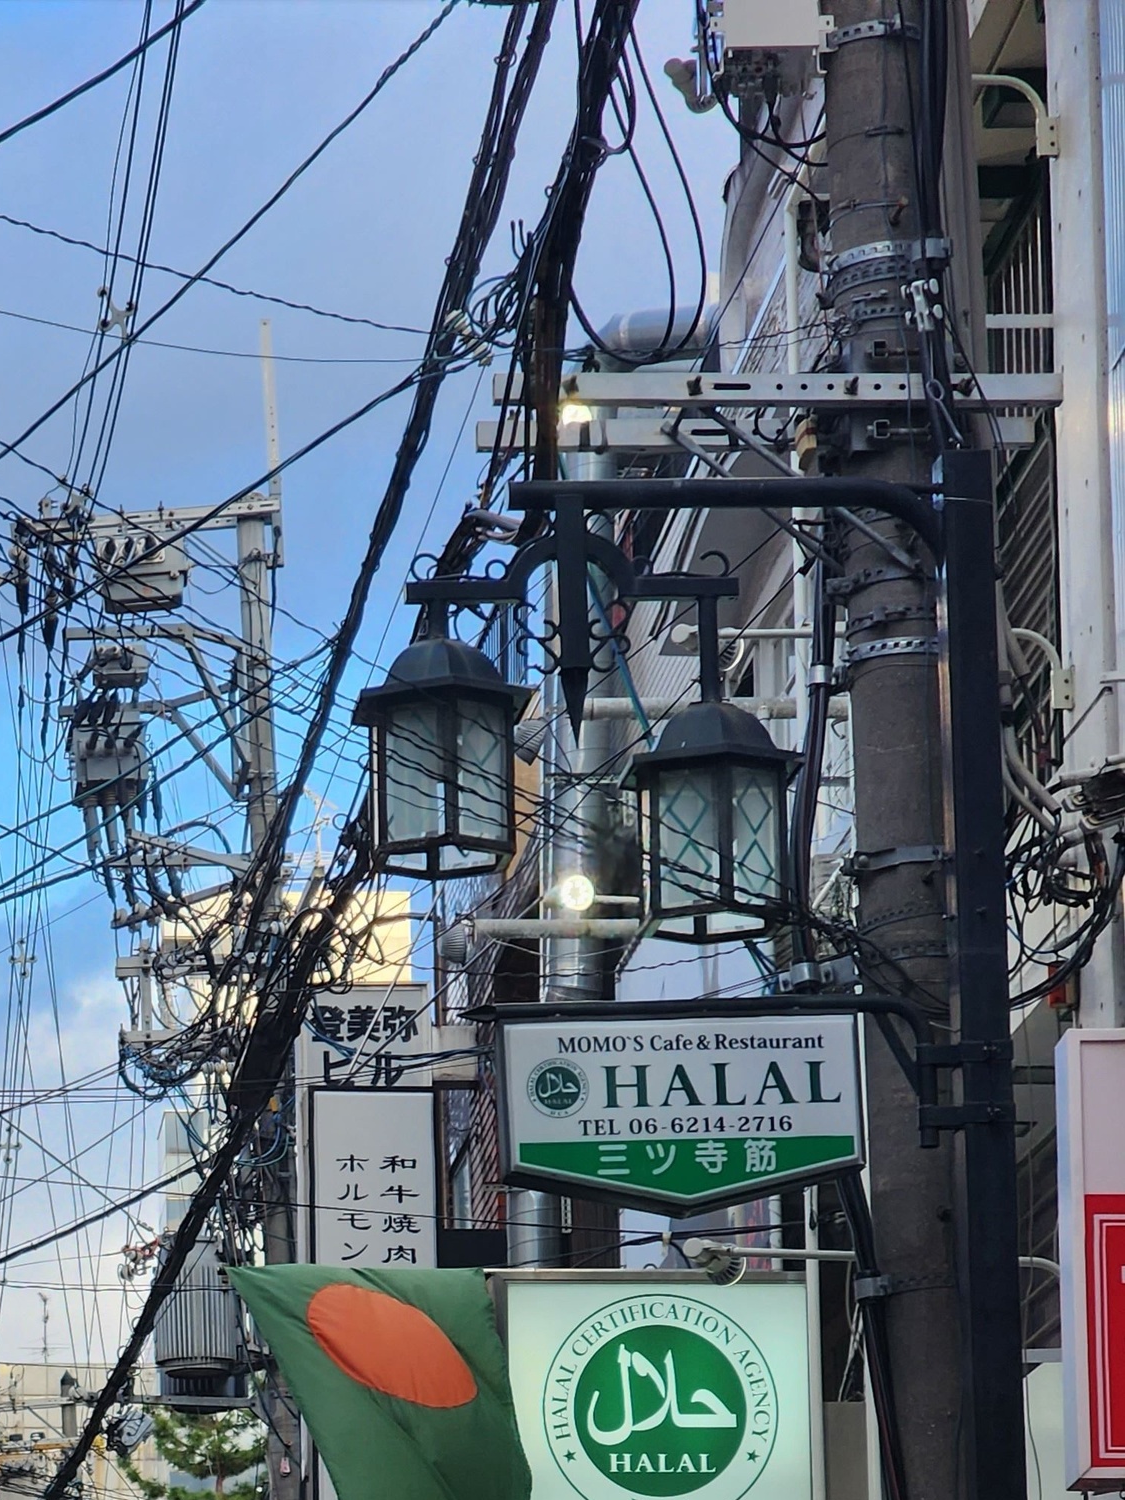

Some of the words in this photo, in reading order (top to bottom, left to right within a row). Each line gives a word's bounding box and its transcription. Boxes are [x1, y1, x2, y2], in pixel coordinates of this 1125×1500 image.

[650, 1034, 693, 1051] Cafe
[697, 1035, 711, 1049] &
[714, 1033, 825, 1050] Restaurant
[601, 1061, 842, 1108] HALAL
[579, 1119, 621, 1136] TEL
[629, 1115, 793, 1134] 06-6214-2716
[597, 1139, 777, 1175] 三ツ寺筋
[336, 1154, 371, 1261] ホルモン
[379, 1155, 421, 1264] 和牛焼肉
[572, 1302, 738, 1357] CERTIFICATION
[552, 1364, 578, 1440] HALAL
[587, 1344, 737, 1445] حلال
[733, 1349, 771, 1443] AGENCY
[609, 1453, 717, 1473] HALAL
